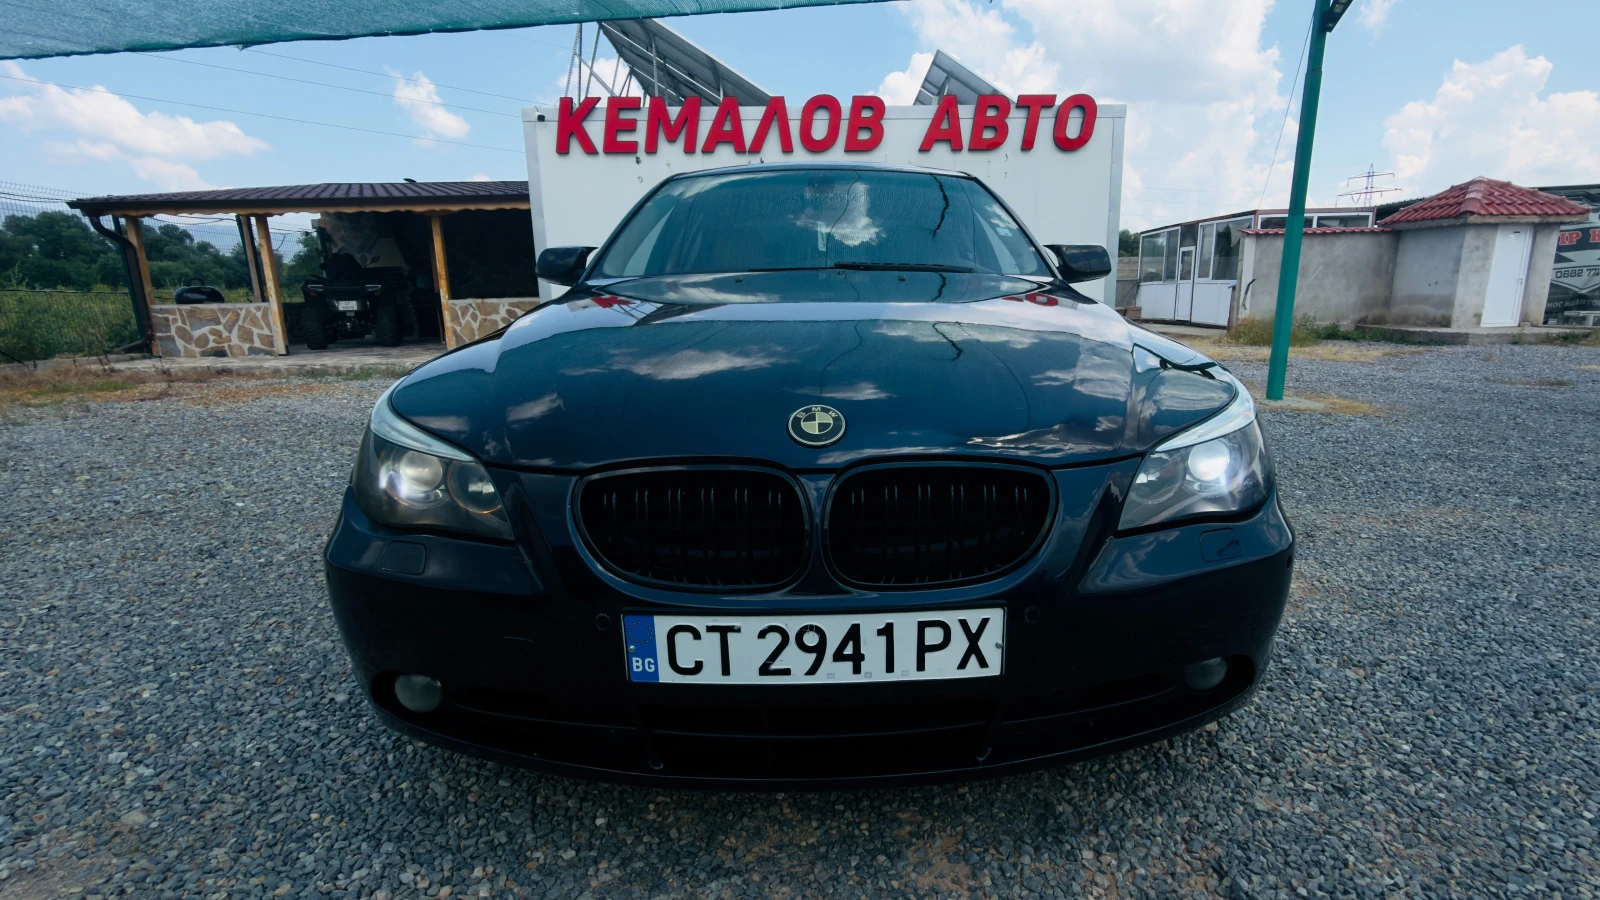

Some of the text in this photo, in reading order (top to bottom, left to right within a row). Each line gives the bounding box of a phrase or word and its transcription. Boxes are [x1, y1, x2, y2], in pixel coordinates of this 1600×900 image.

[556, 93, 1098, 154] КЕМАЛОВ АВТО
[1555, 269, 1583, 278] 0882
[796, 407, 838, 418] BMW
[666, 616, 991, 677] CT 2941 PX
[632, 656, 655, 673] BG
